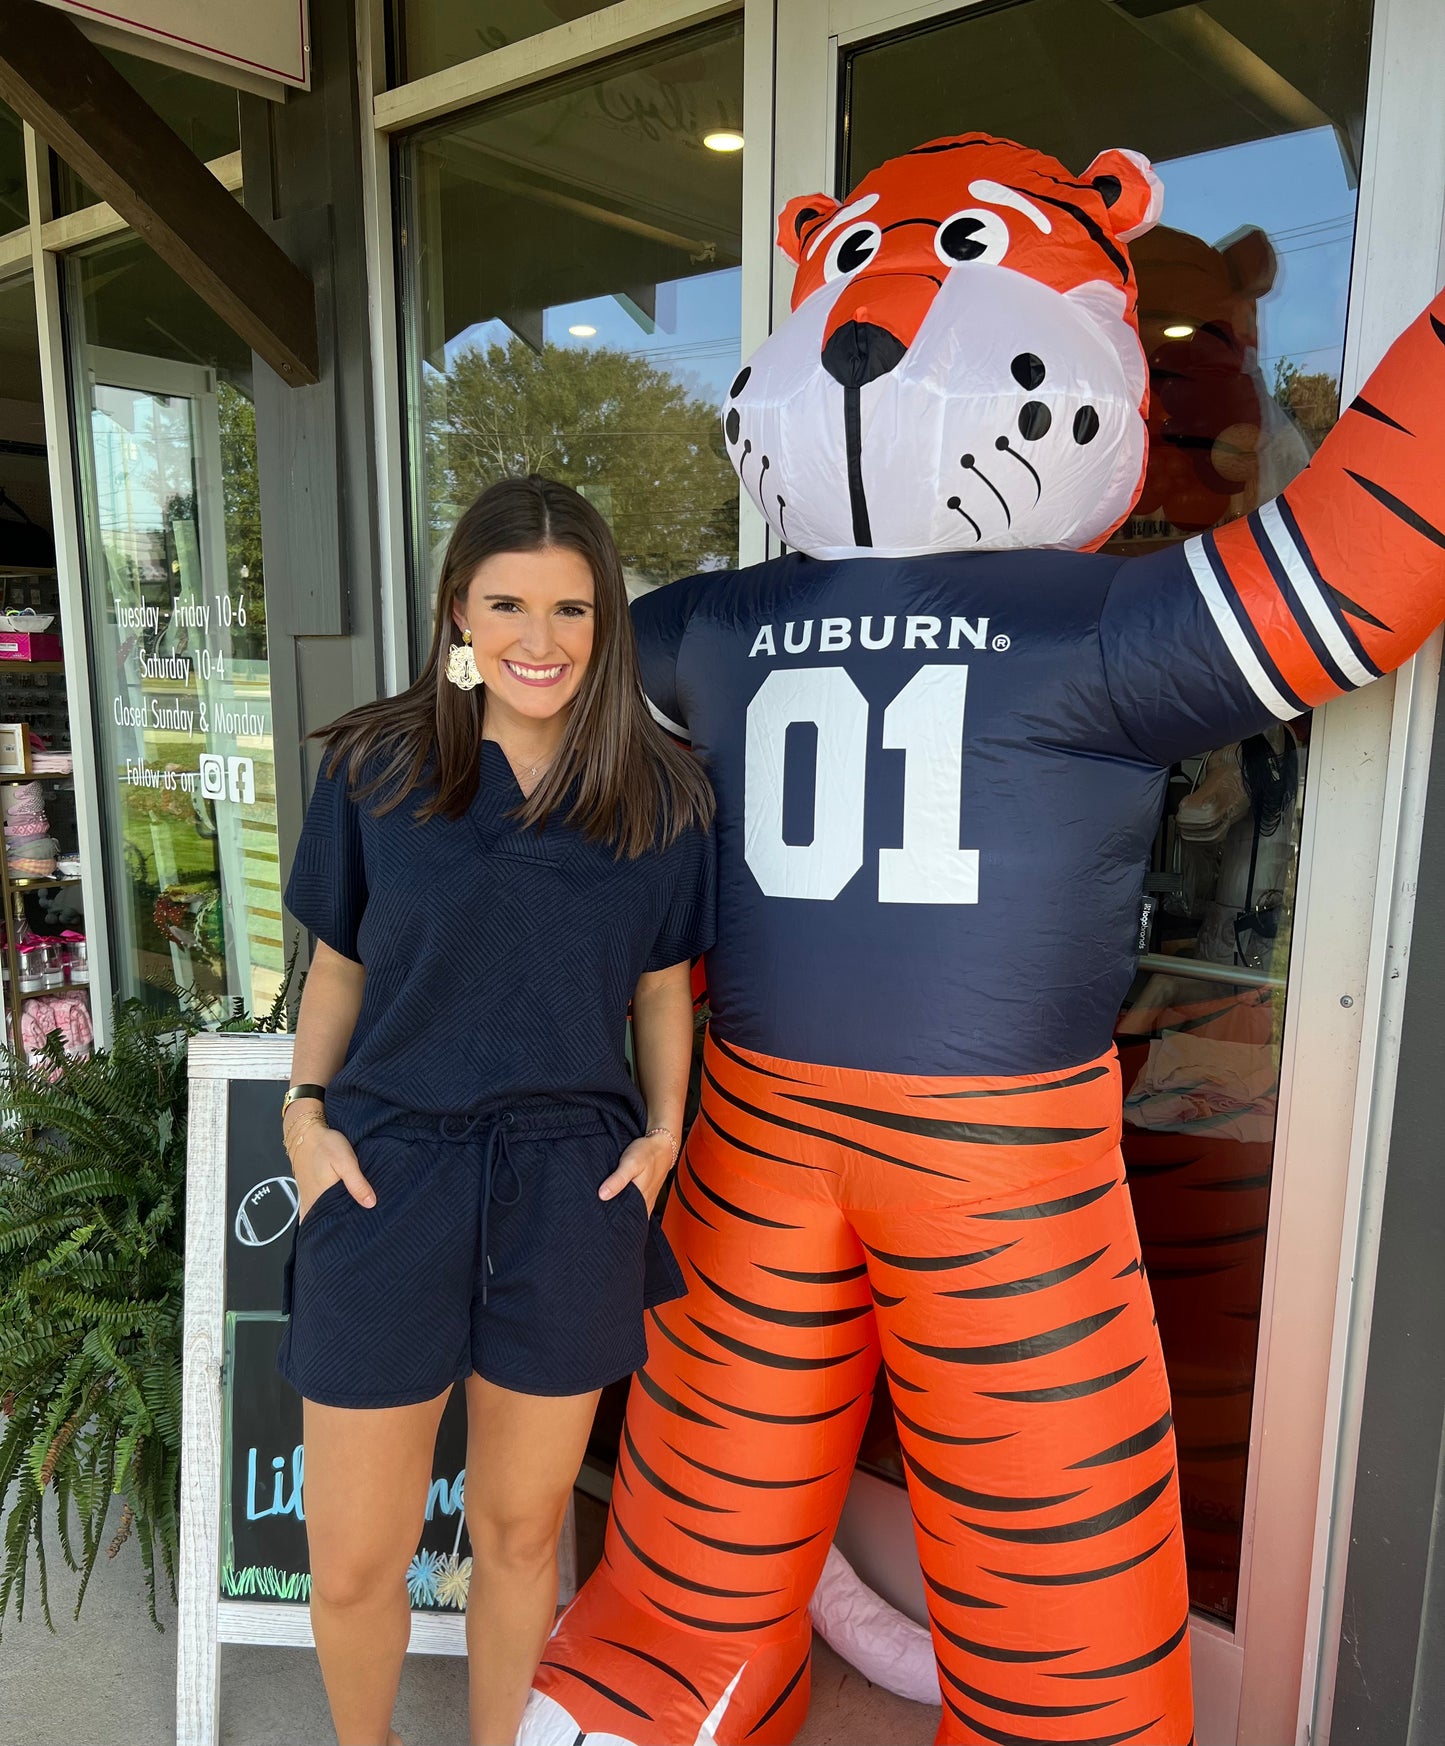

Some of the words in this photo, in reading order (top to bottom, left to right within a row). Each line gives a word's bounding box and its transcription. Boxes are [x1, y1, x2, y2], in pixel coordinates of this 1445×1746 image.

[115, 595, 160, 635] Tuesday
[174, 594, 210, 634] Friday
[215, 594, 247, 627] 10-6
[140, 646, 190, 686] Saturday
[195, 649, 225, 680] 10-4
[114, 696, 148, 728] Closed
[151, 698, 194, 738] Sunday
[199, 701, 209, 733] &
[215, 702, 265, 738] Monday
[126, 758, 160, 788] Follow
[164, 770, 177, 791] us
[181, 771, 195, 793] on
[744, 664, 980, 904] 01
[247, 1444, 305, 1520] Lil
